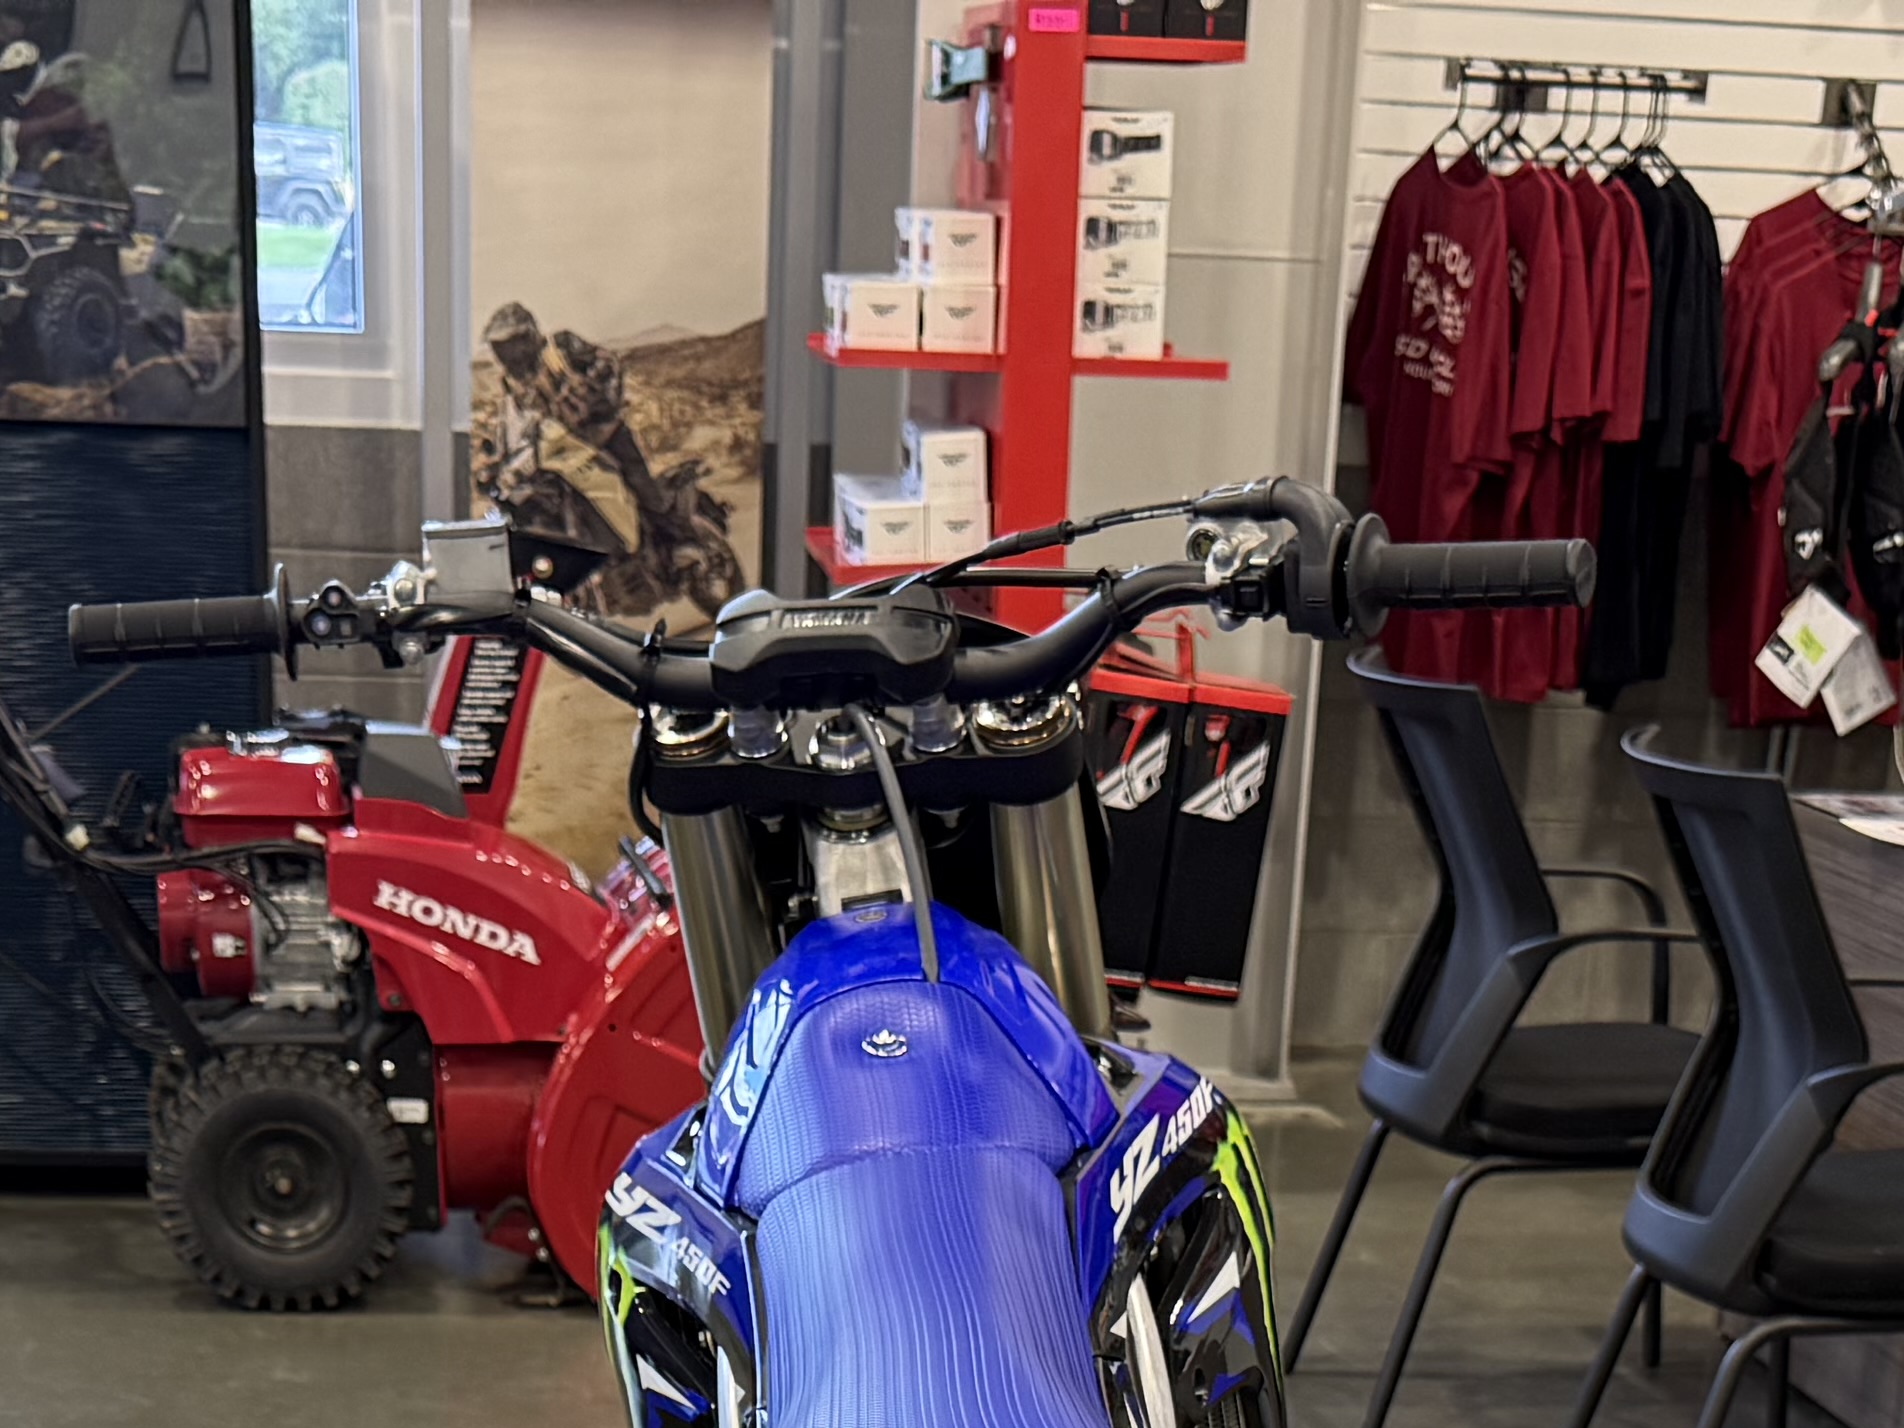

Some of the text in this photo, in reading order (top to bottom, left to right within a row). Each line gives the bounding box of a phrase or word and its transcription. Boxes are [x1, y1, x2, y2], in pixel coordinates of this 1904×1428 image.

[373, 878, 541, 966] HONDA
[1110, 1076, 1213, 1245] YZ 450F
[604, 1172, 732, 1296] YZ 450F
